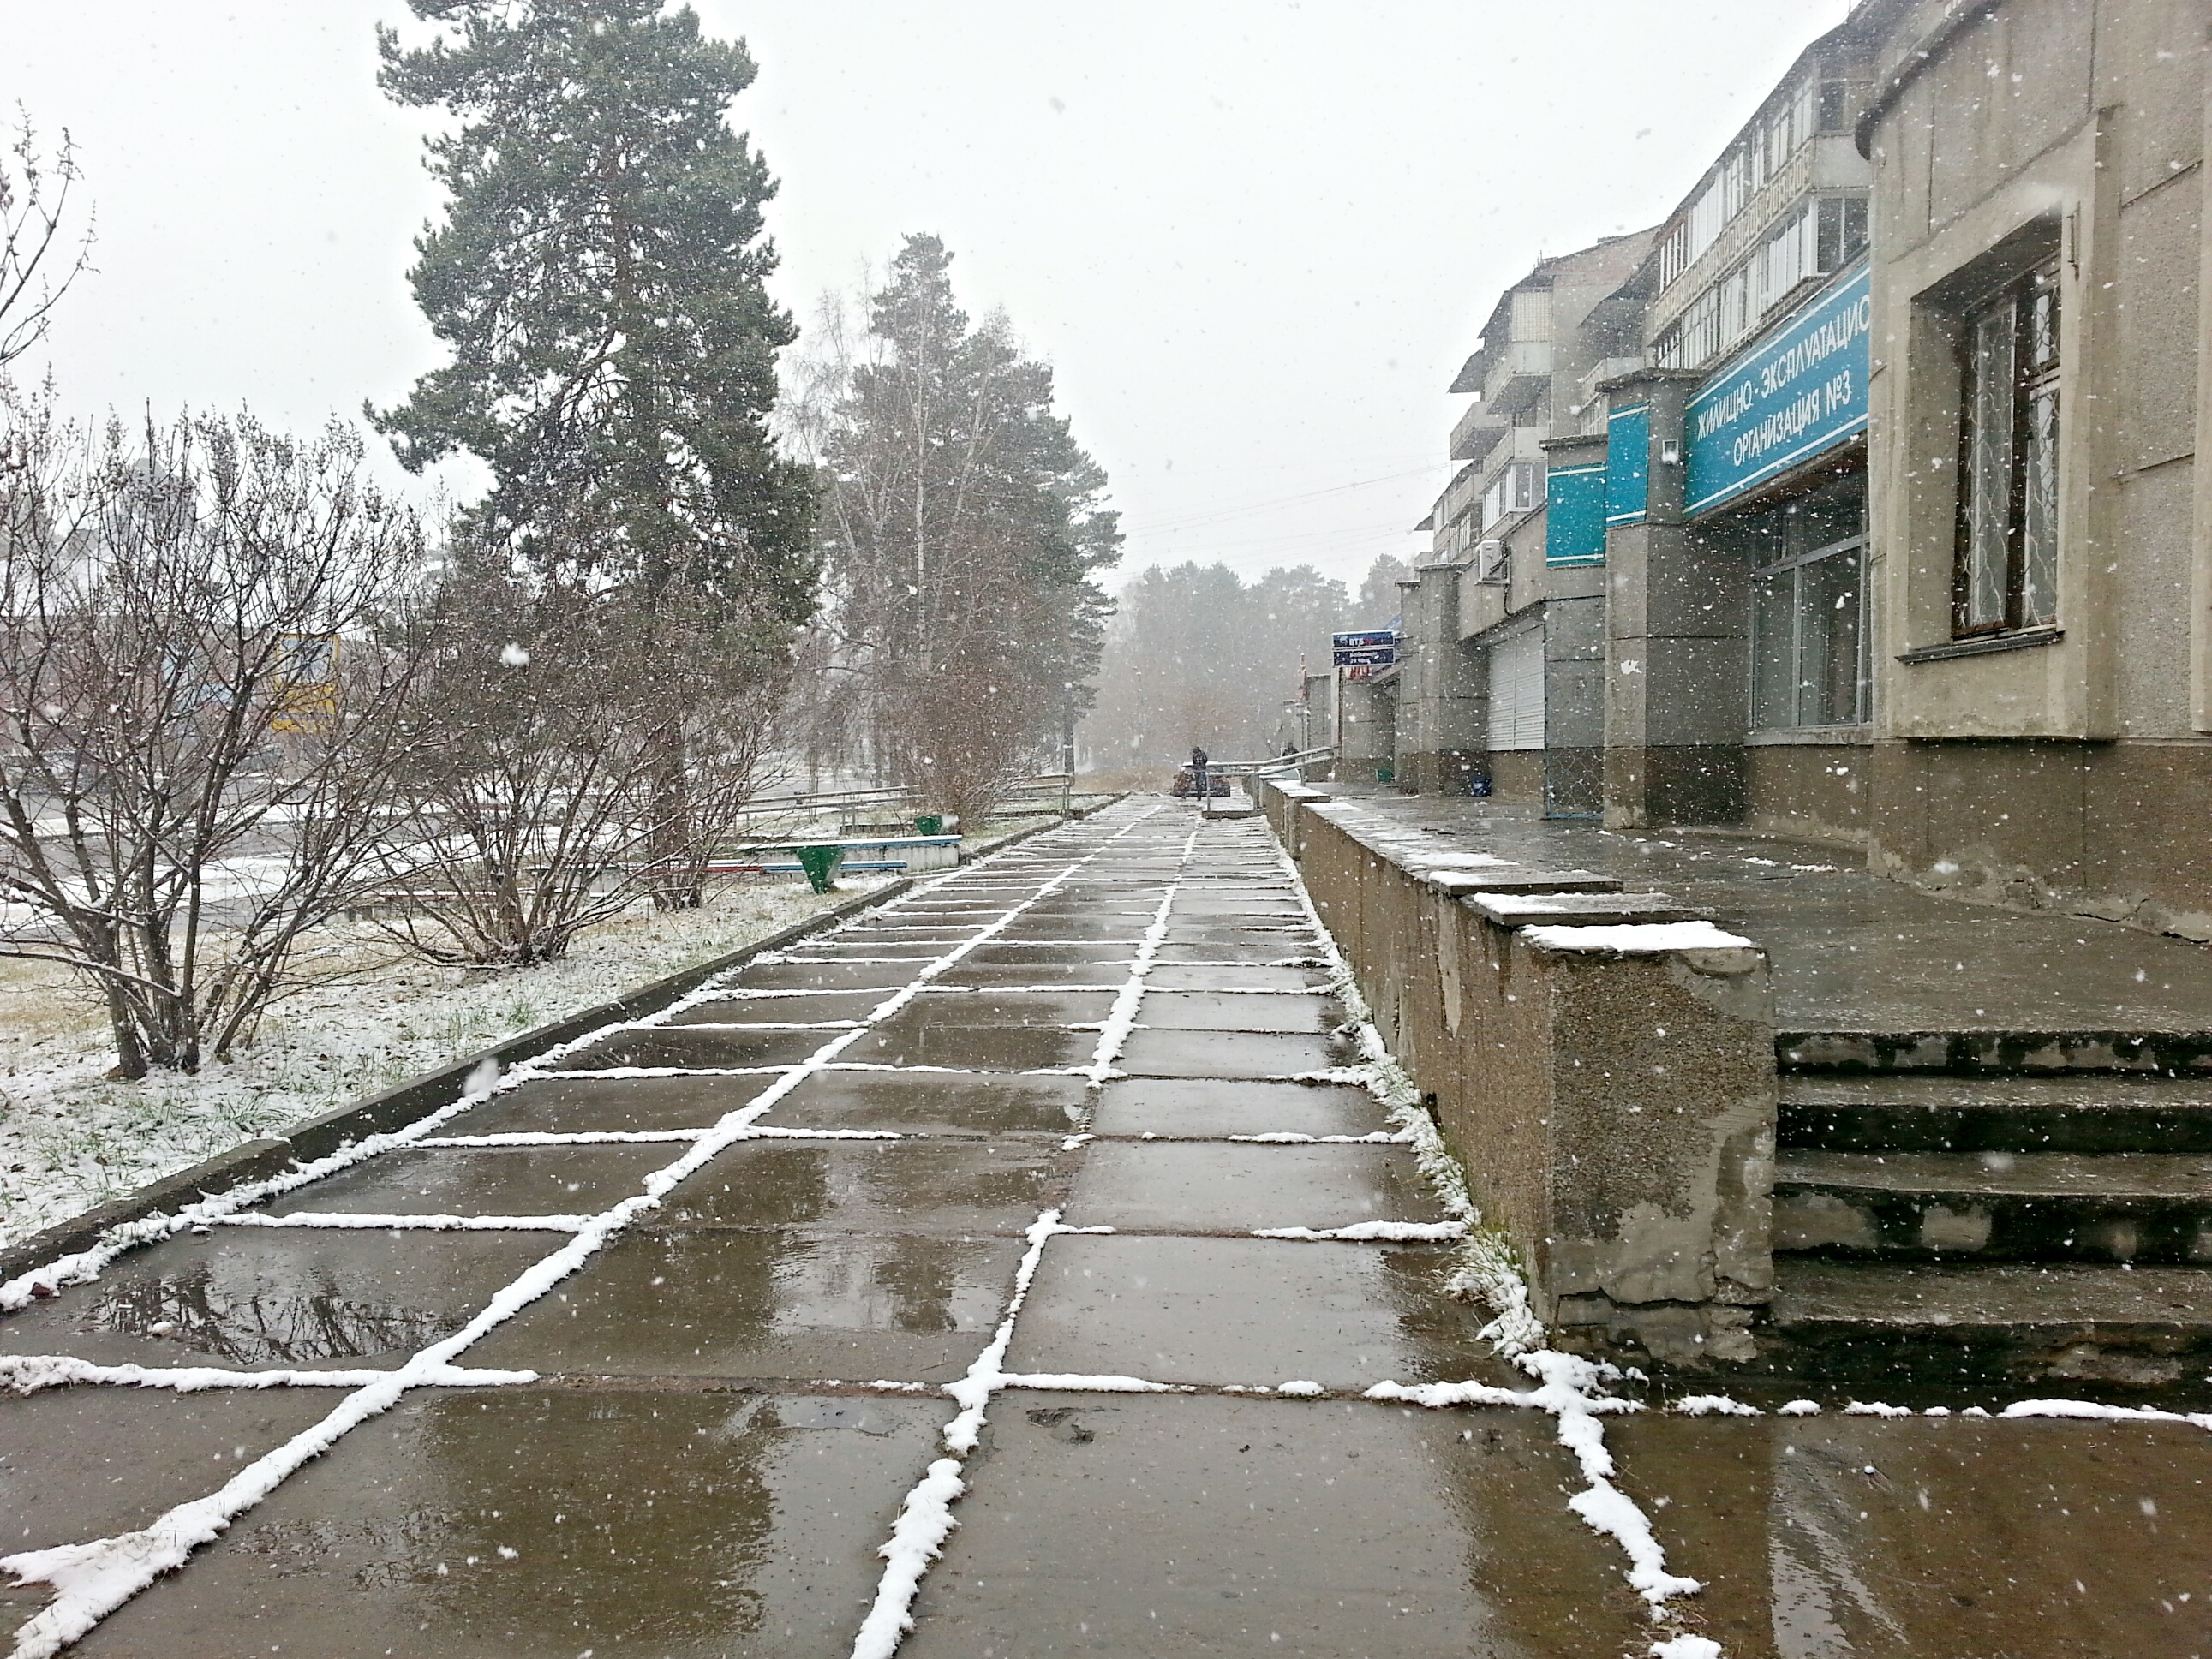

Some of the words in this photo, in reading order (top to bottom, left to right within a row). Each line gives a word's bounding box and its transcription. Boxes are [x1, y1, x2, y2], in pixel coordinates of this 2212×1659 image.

[1697, 380, 1753, 442] ЖИЛИЩНО
[1733, 389, 1820, 467] ОРГАНИЗАЦИЯ
[1826, 370, 1851, 412] №3
